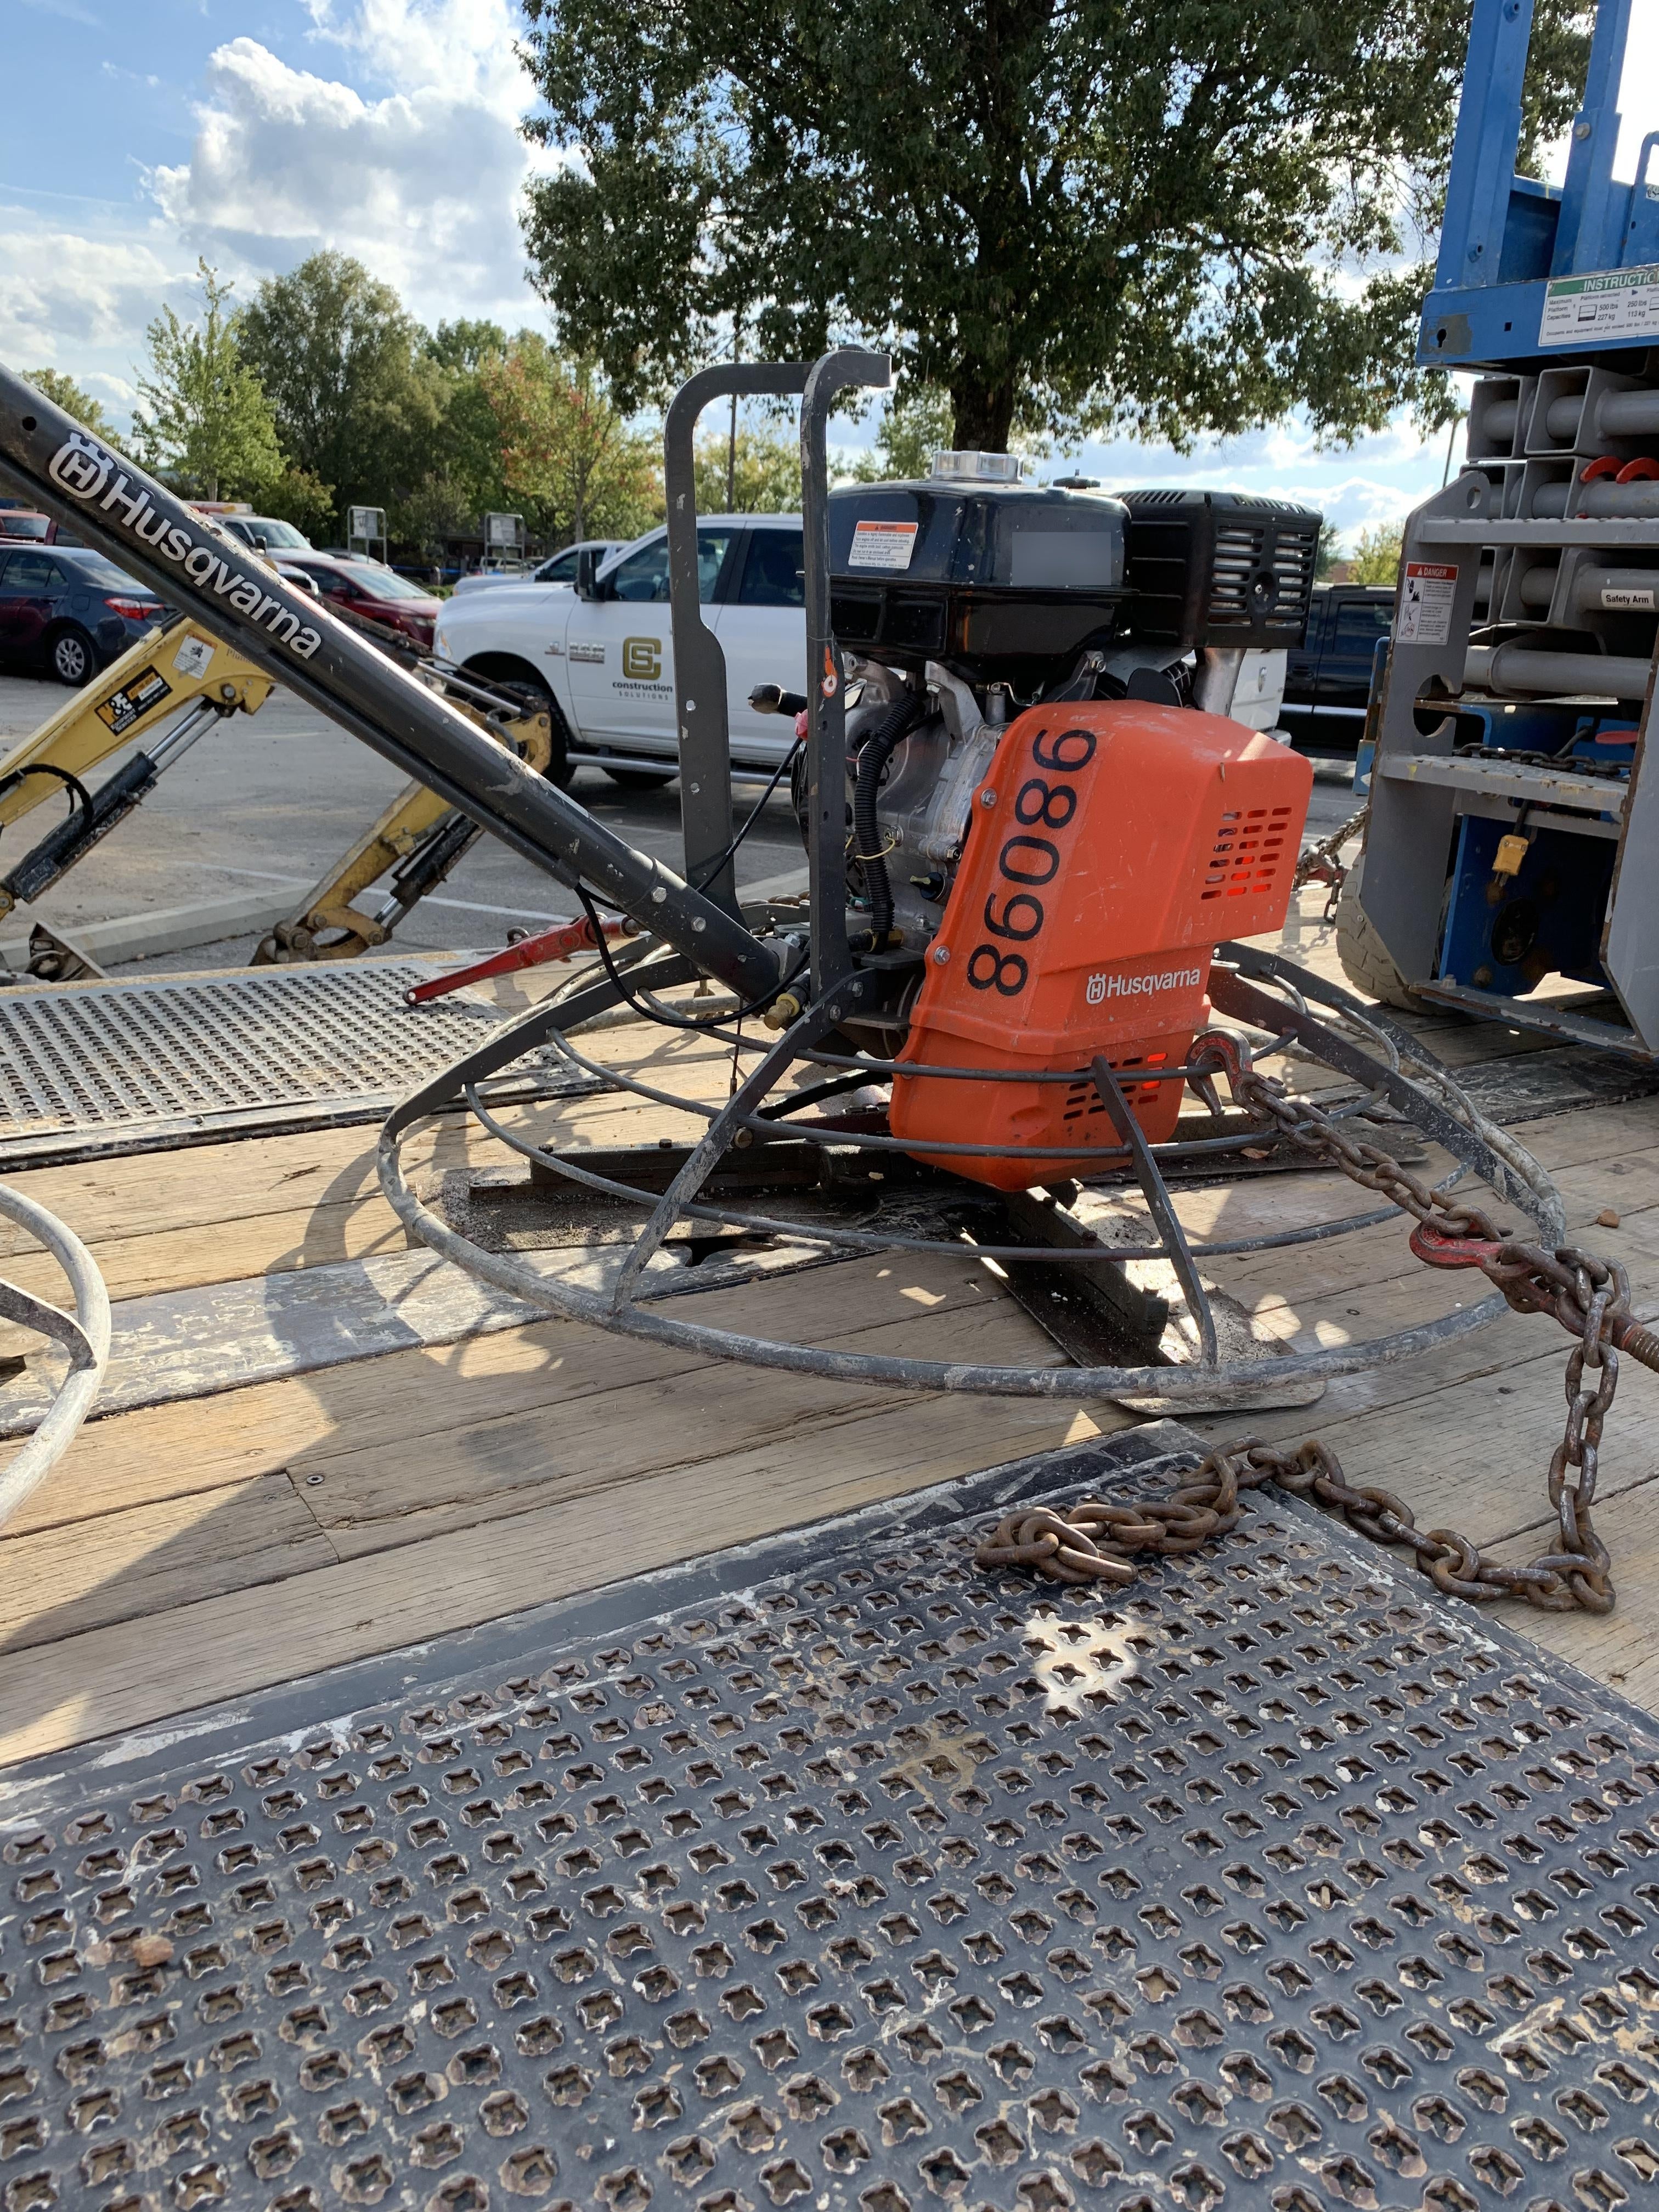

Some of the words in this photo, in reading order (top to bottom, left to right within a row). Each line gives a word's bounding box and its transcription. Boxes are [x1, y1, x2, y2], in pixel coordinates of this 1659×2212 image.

[99, 474, 321, 659] Husqvarna
[1424, 567, 1447, 577] DANGER
[1606, 594, 1630, 605] Safety
[1633, 595, 1649, 603] Arm
[612, 681, 674, 692] construction
[619, 690, 669, 701] SOLUTIONS
[967, 729, 1097, 997] 86086
[1108, 967, 1201, 998] Husqvarna
